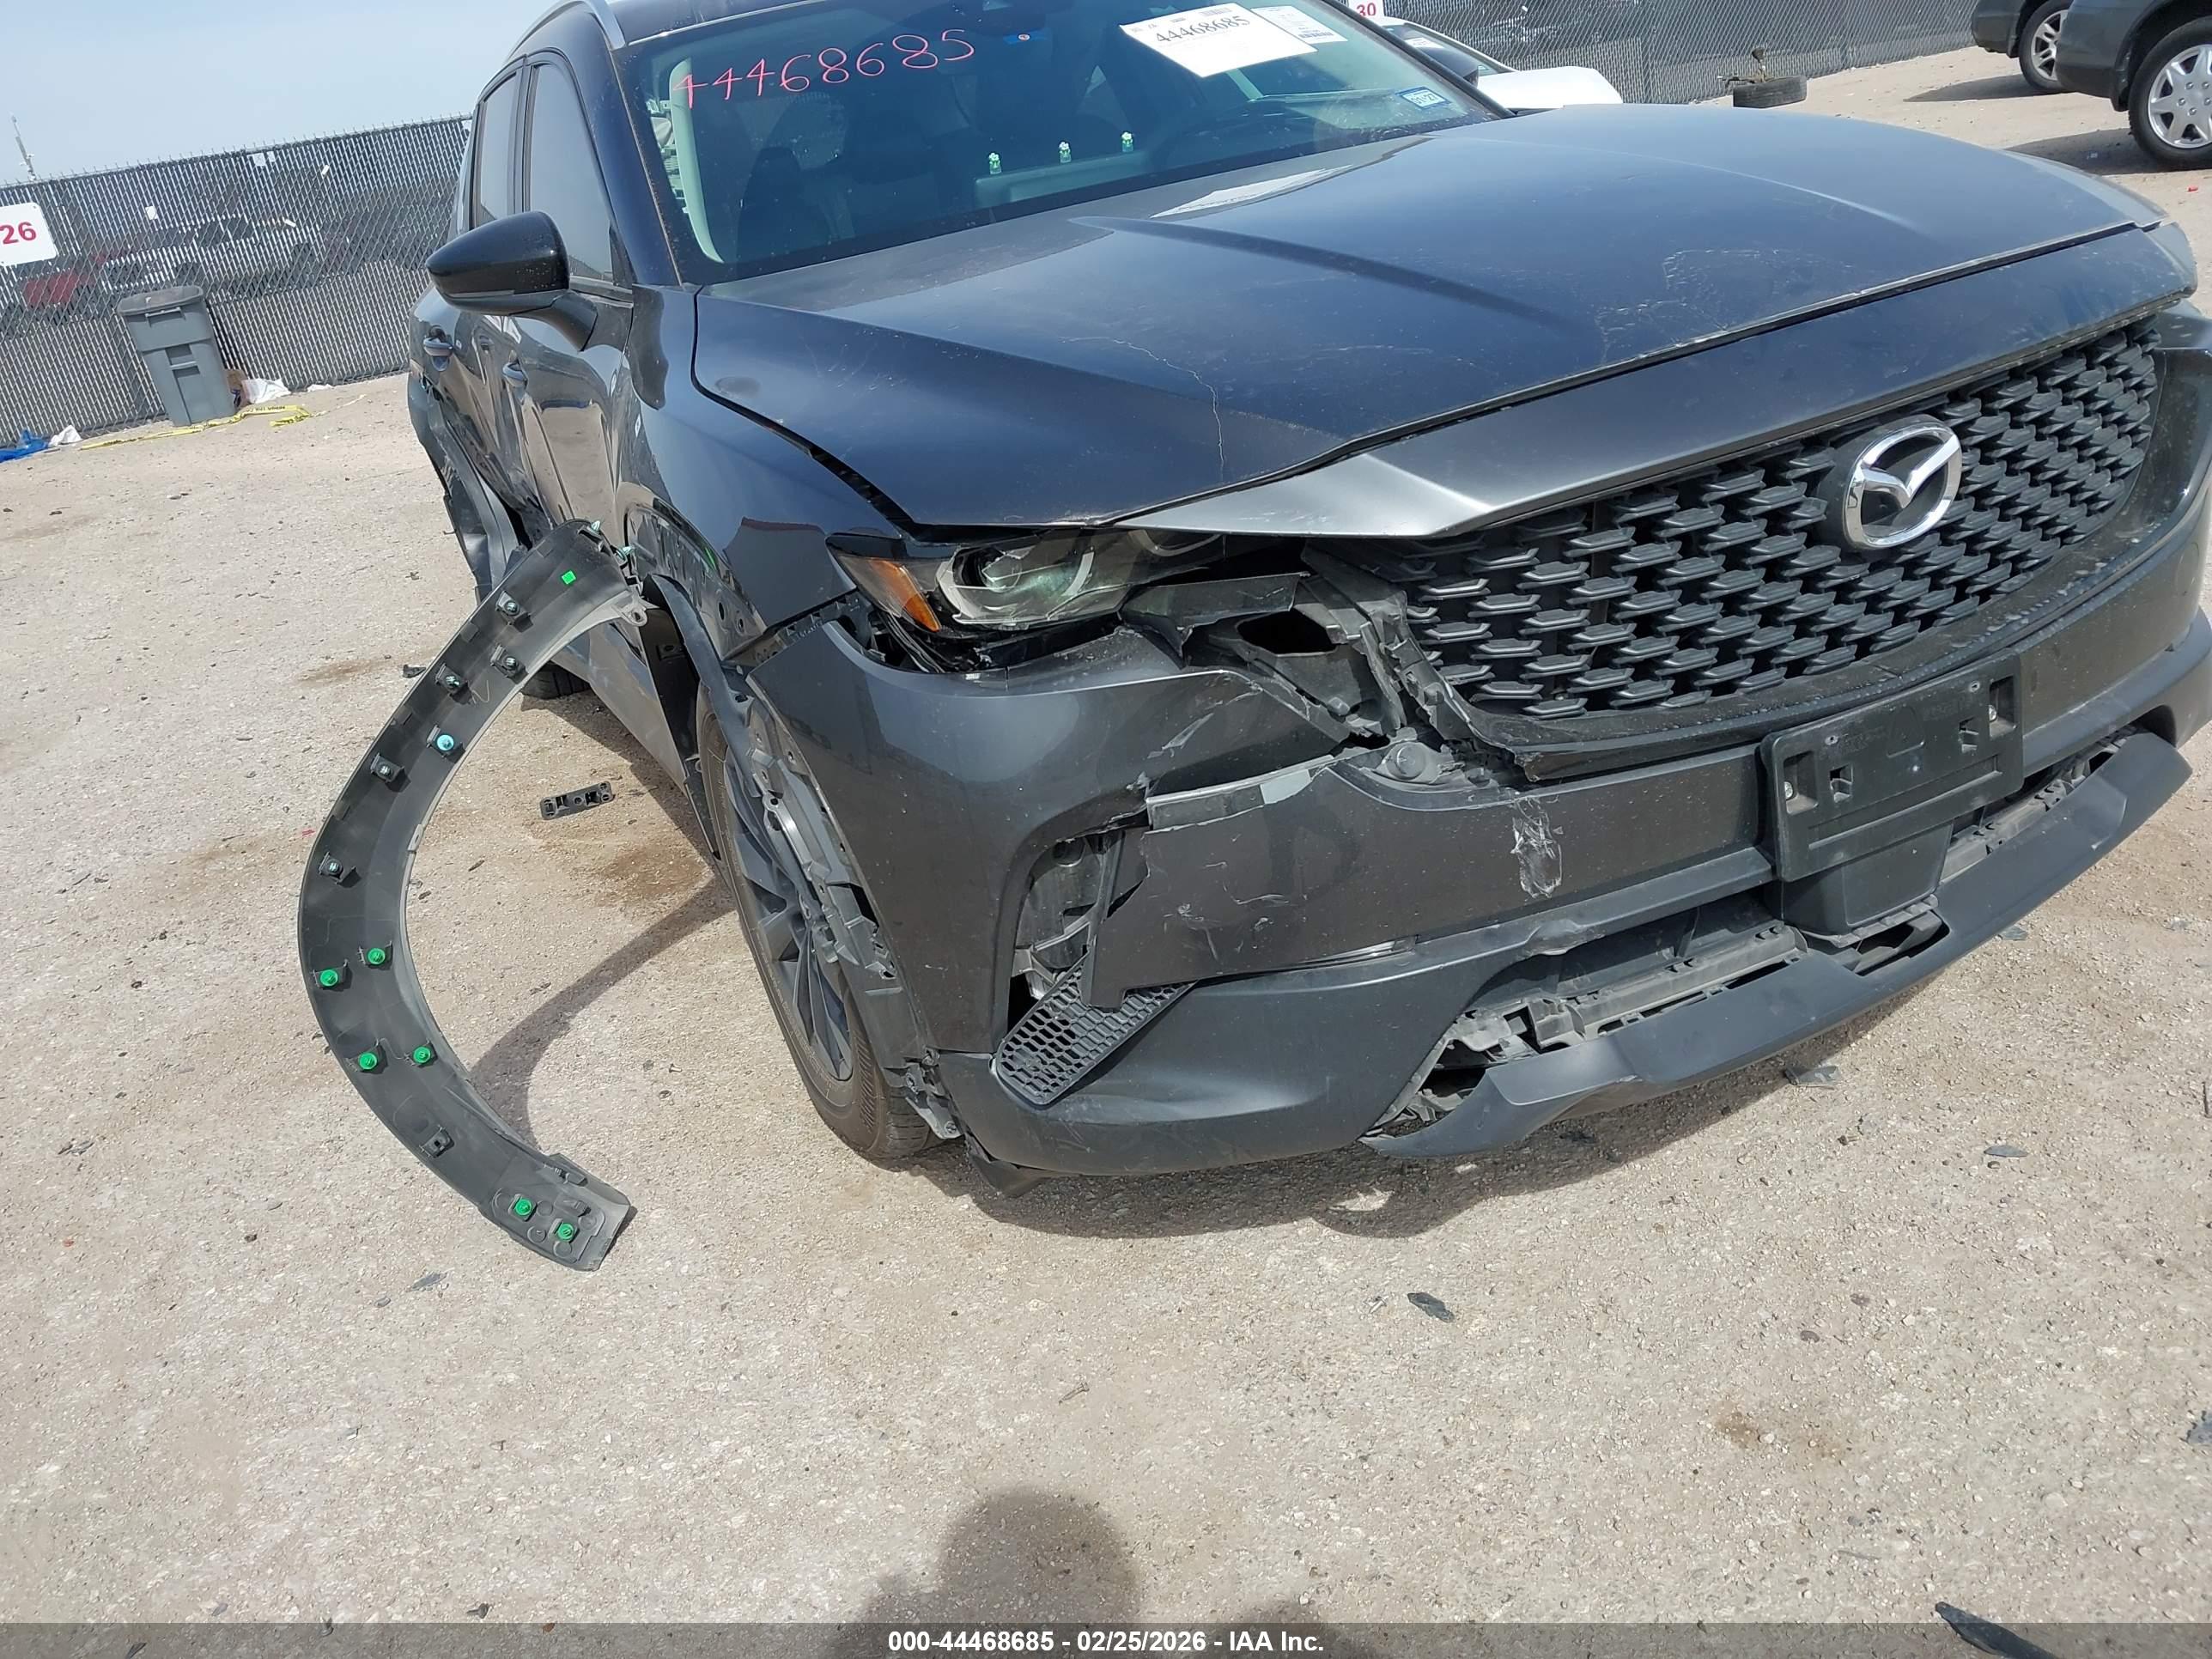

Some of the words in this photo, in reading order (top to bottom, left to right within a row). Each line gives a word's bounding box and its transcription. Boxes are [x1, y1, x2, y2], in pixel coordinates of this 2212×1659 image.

[1156, 15, 1251, 42] 44468685
[673, 28, 975, 110] 44468685
[0, 222, 37, 245] 26
